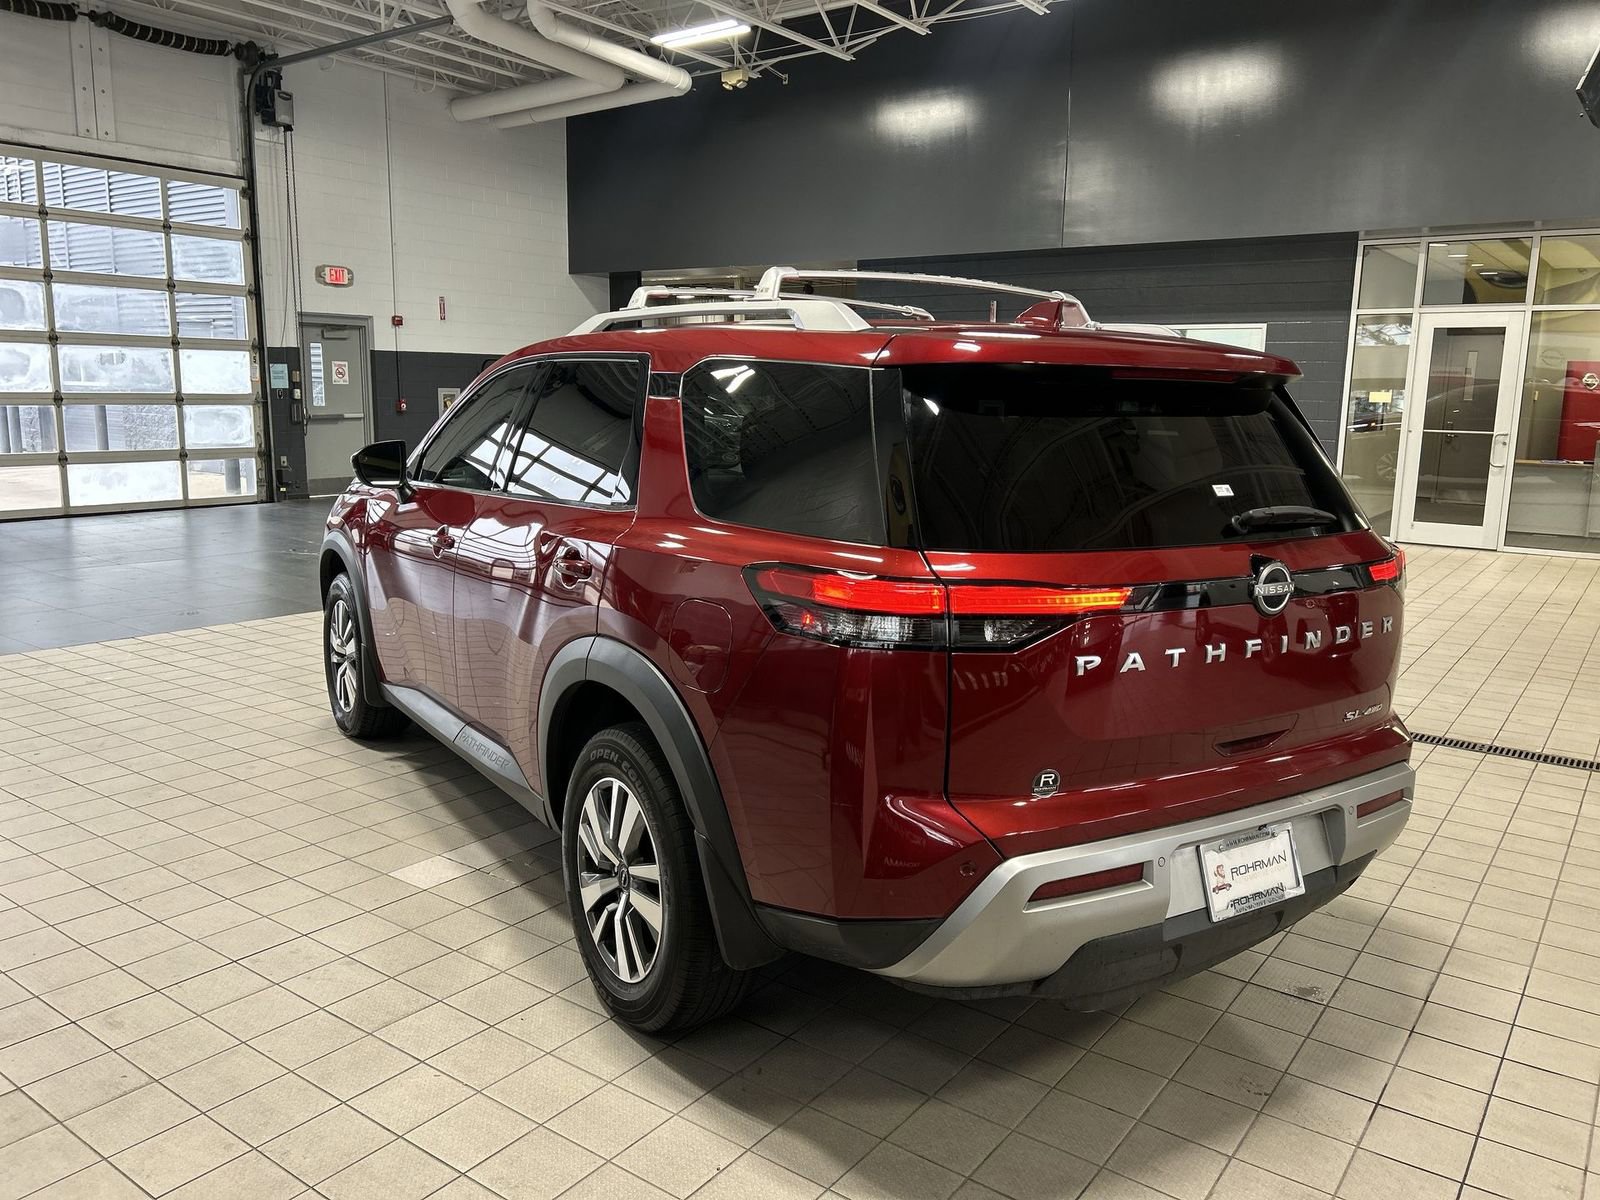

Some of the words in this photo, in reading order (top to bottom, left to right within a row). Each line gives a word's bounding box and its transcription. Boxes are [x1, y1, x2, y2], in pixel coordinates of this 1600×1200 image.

[329, 268, 346, 282] EXIT
[1254, 583, 1295, 595] NISSAN
[1075, 615, 1393, 676] PATHFINDER
[1343, 709, 1361, 722] SL
[458, 731, 511, 770] PATHFINDER
[590, 748, 619, 762] OPEN
[1040, 773, 1055, 787] R
[1230, 849, 1287, 880] ROHRMAN
[1232, 882, 1286, 910] ROHRMAN
